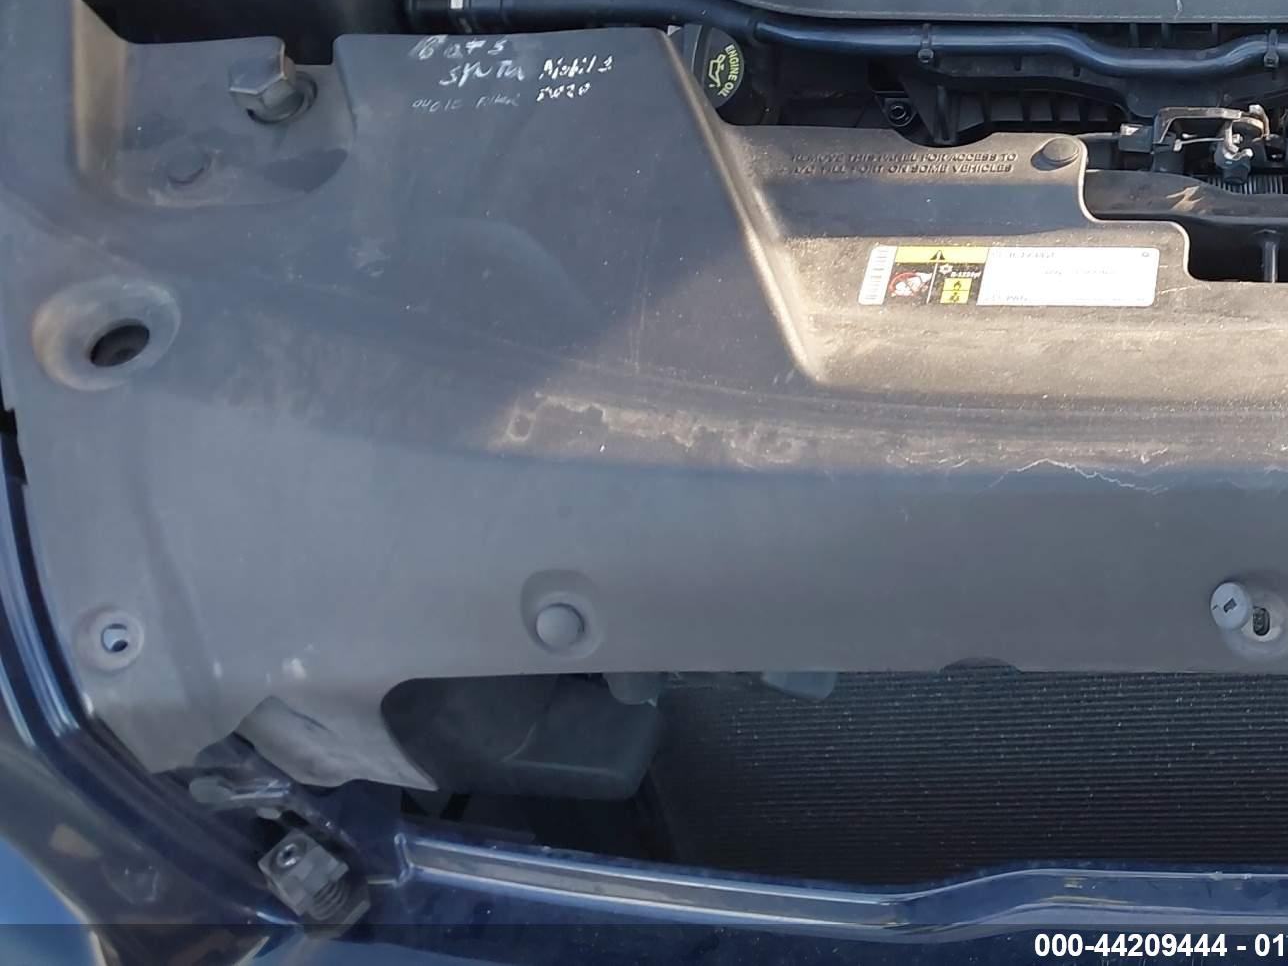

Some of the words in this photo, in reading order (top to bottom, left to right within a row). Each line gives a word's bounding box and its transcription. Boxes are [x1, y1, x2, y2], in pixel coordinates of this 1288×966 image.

[724, 44, 740, 82] ENGINE
[717, 81, 735, 97] OIL
[950, 153, 998, 162] ACCESS
[1000, 153, 1018, 162] TO
[888, 164, 909, 174] ON
[911, 164, 948, 173] SOME
[952, 164, 1014, 173] VEHICLES
